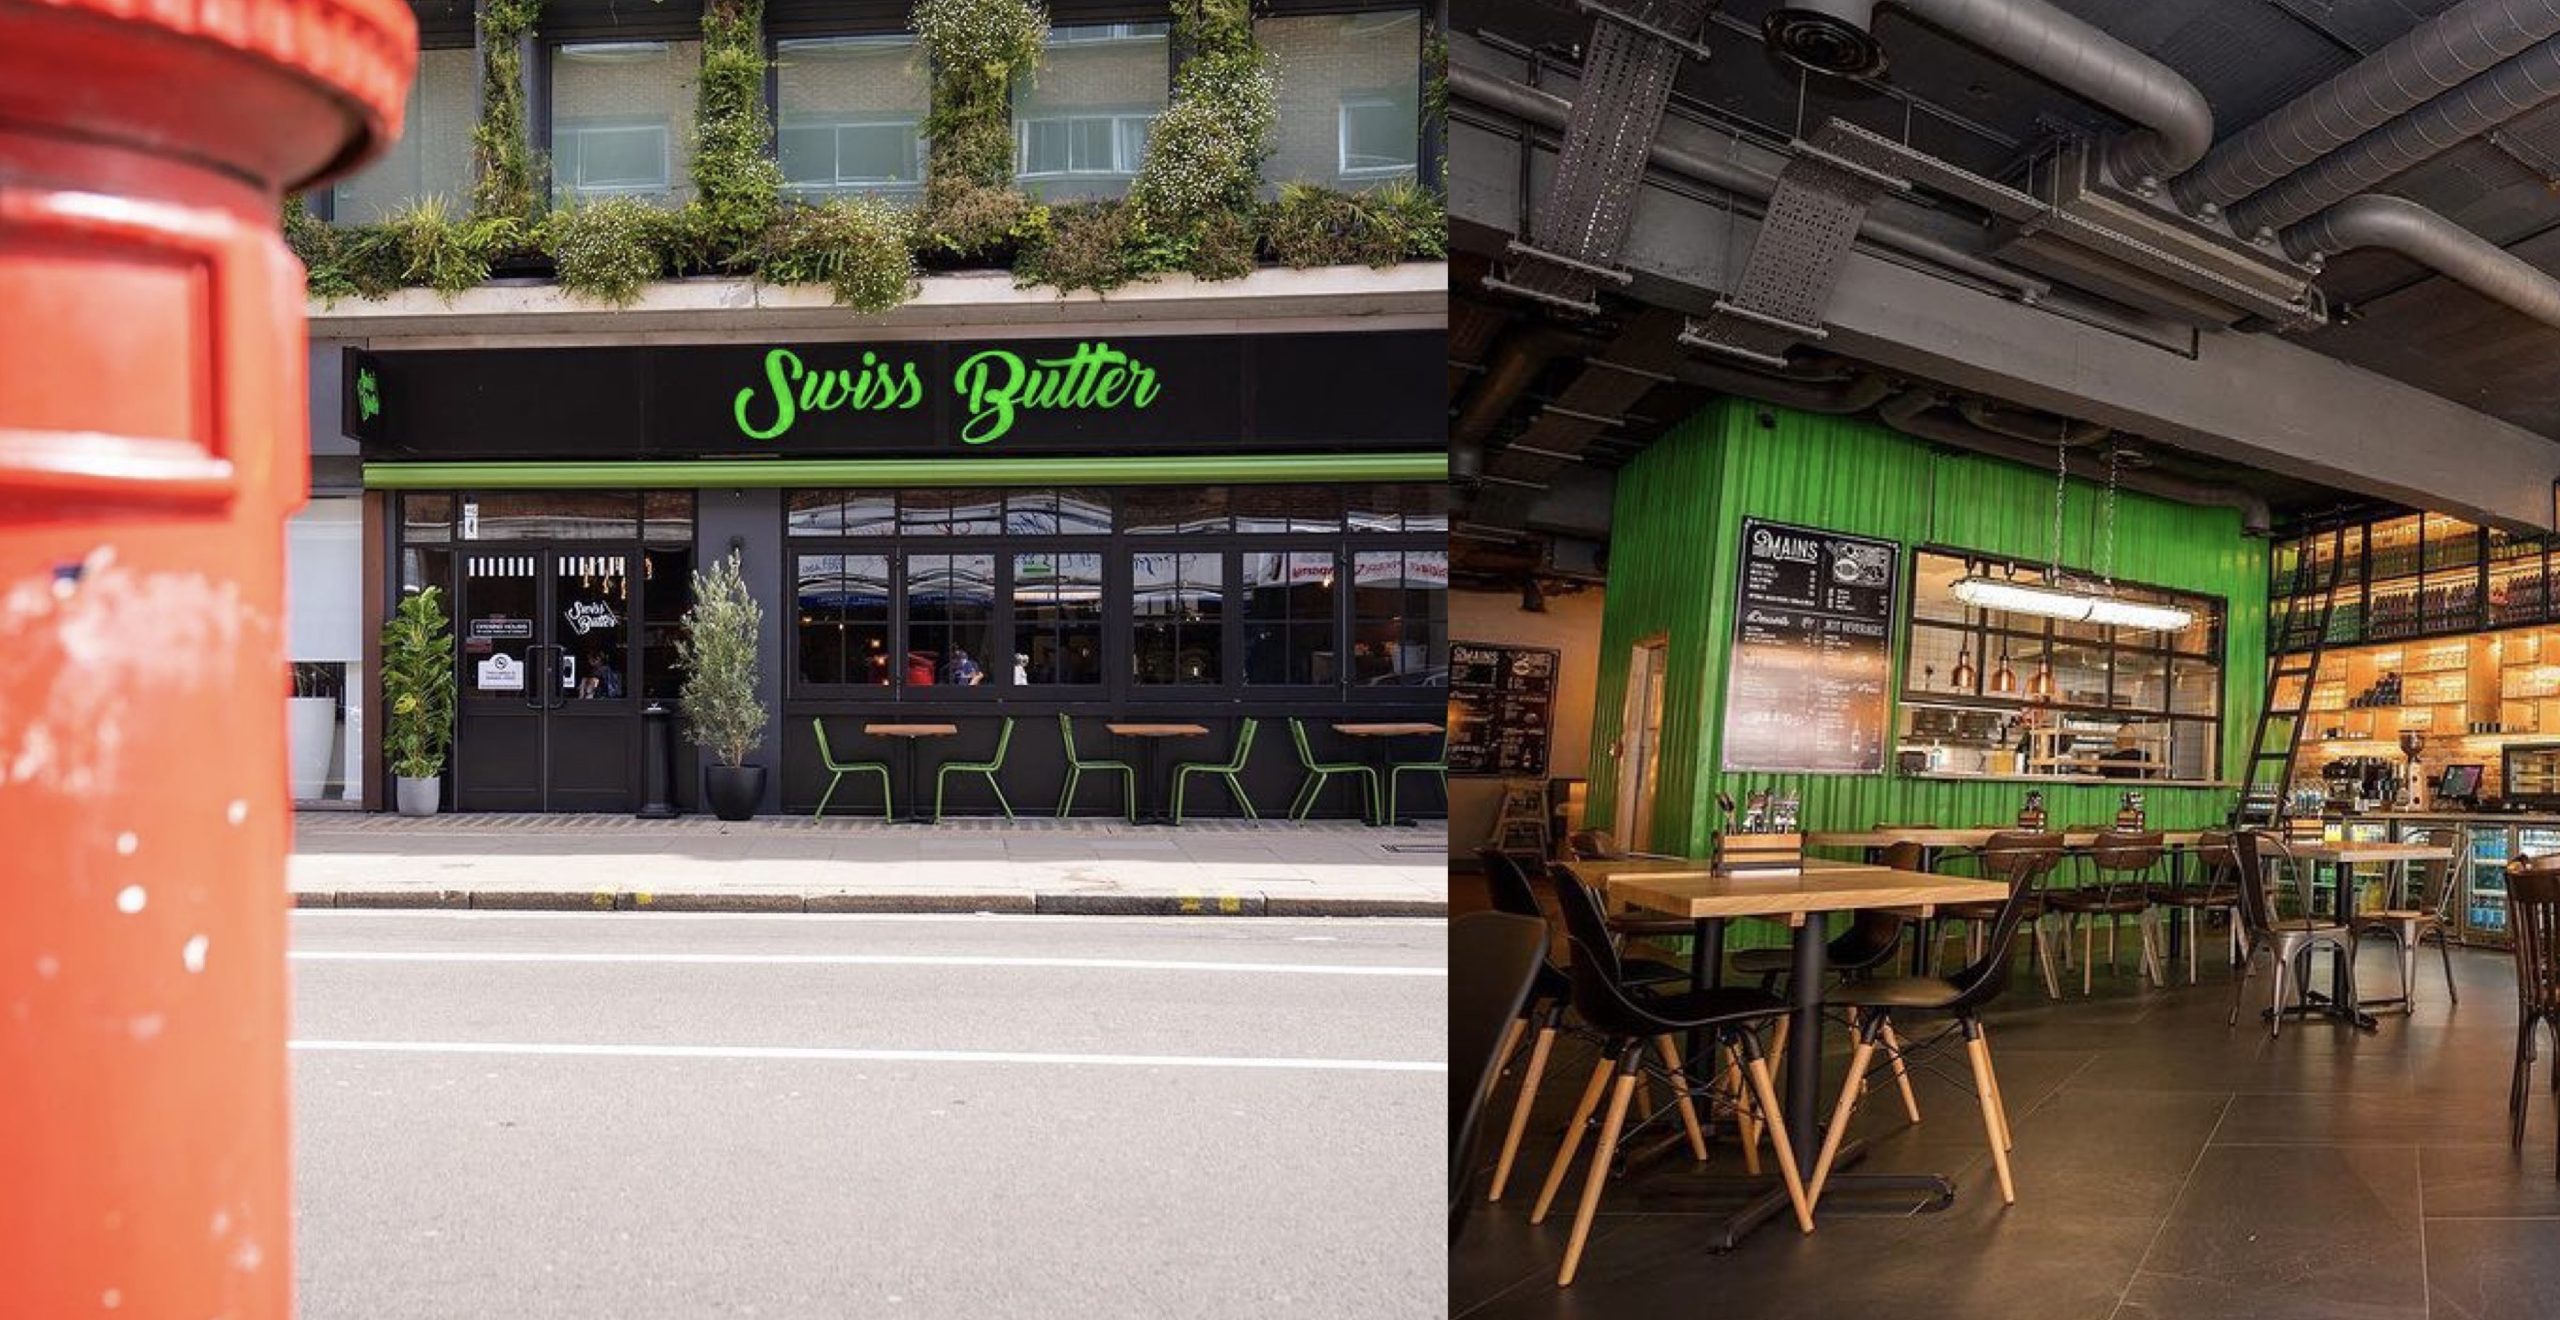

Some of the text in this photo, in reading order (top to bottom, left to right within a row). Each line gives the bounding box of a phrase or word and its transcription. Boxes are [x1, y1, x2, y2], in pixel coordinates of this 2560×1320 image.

[734, 343, 1161, 445] Swiss Butter
[1768, 535, 1818, 561] MAINS
[568, 601, 604, 620] Swiss
[577, 615, 615, 635] Butter
